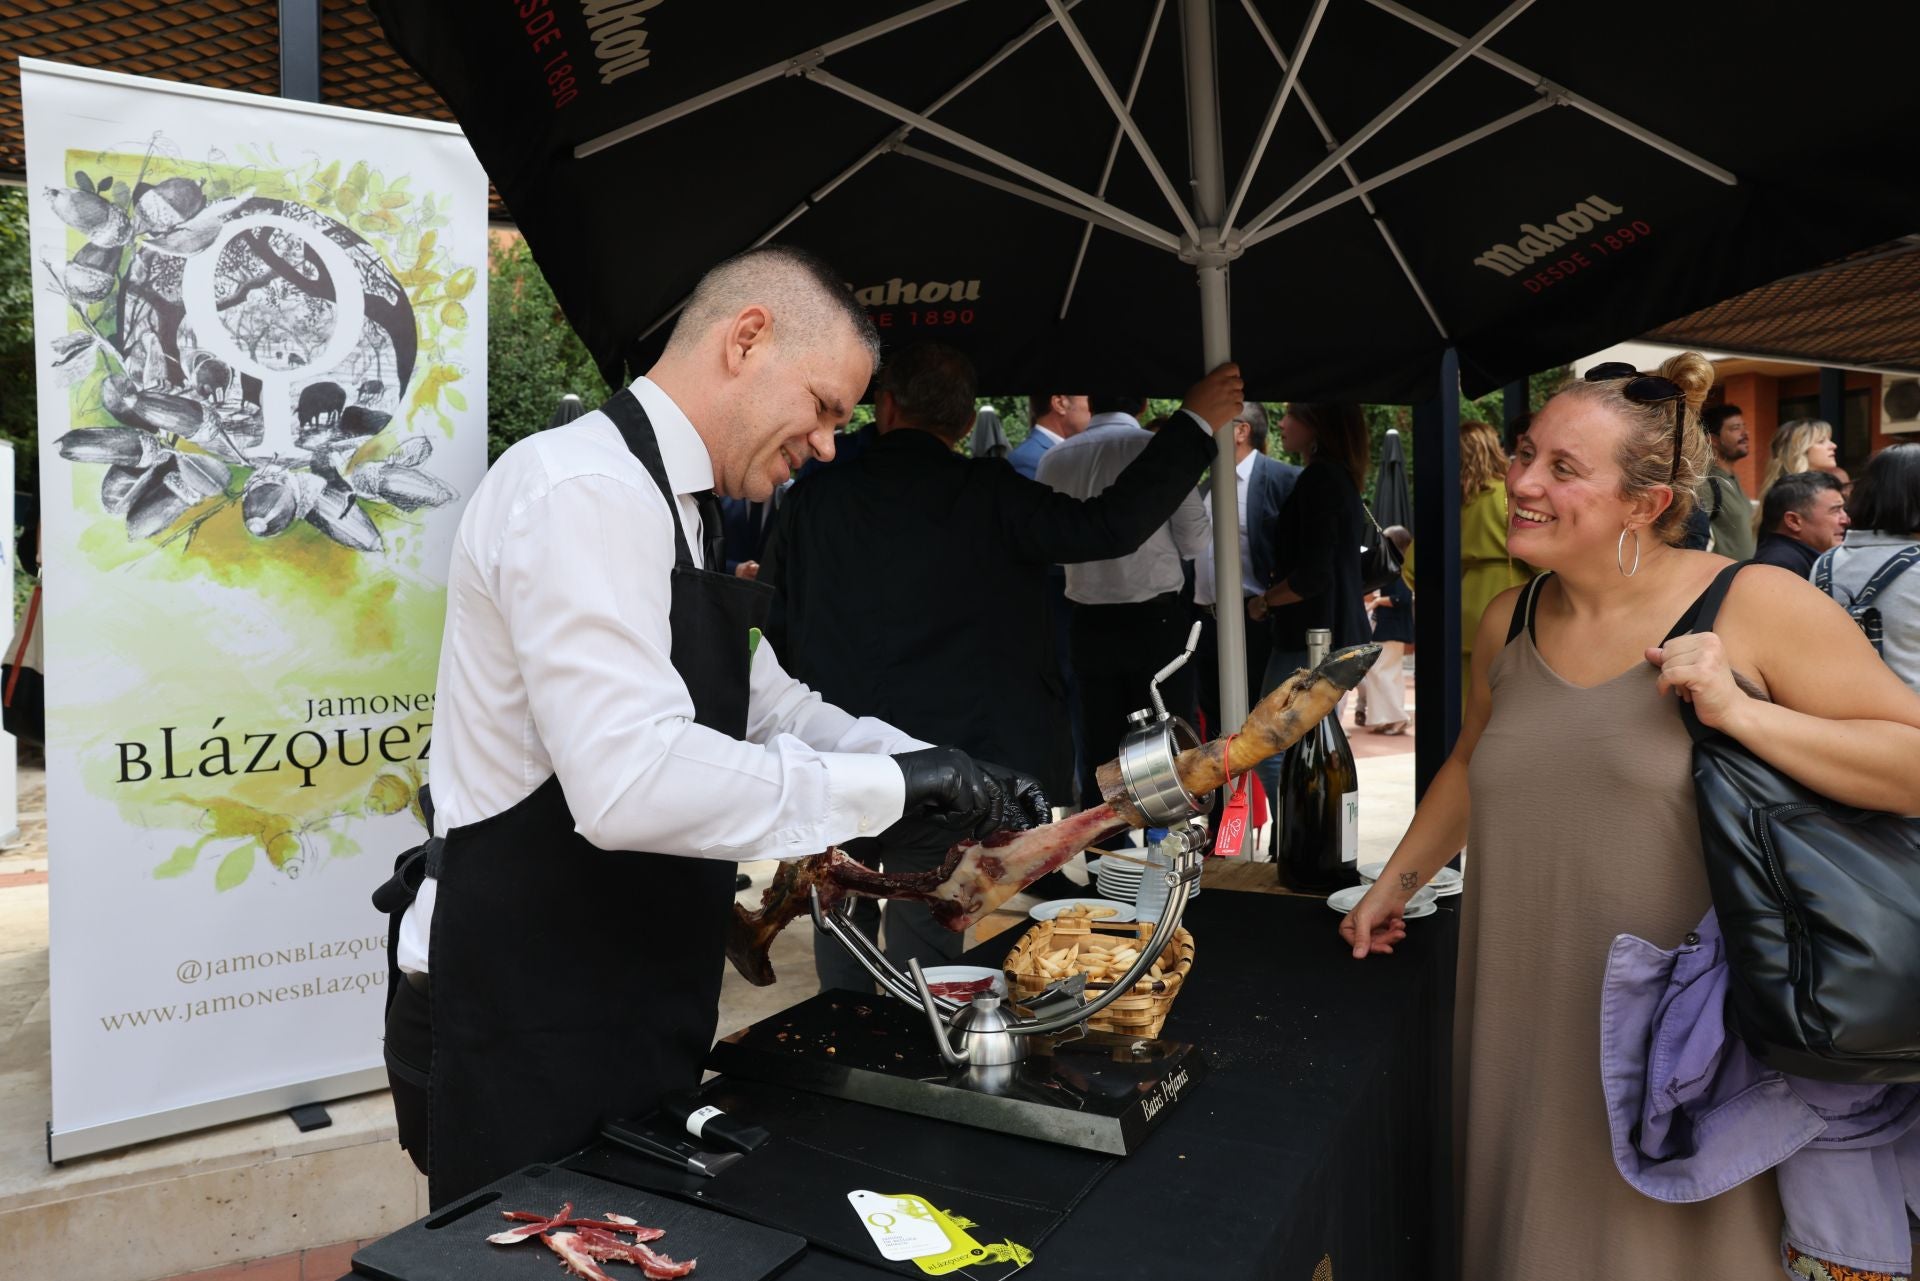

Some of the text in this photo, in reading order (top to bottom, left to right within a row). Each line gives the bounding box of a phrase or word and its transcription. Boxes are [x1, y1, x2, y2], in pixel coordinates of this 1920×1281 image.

[513, 0, 579, 109] SDE 1890
[1523, 220, 1652, 294] DESDE 1890
[843, 277, 981, 306] ahou
[910, 309, 975, 326] 1890
